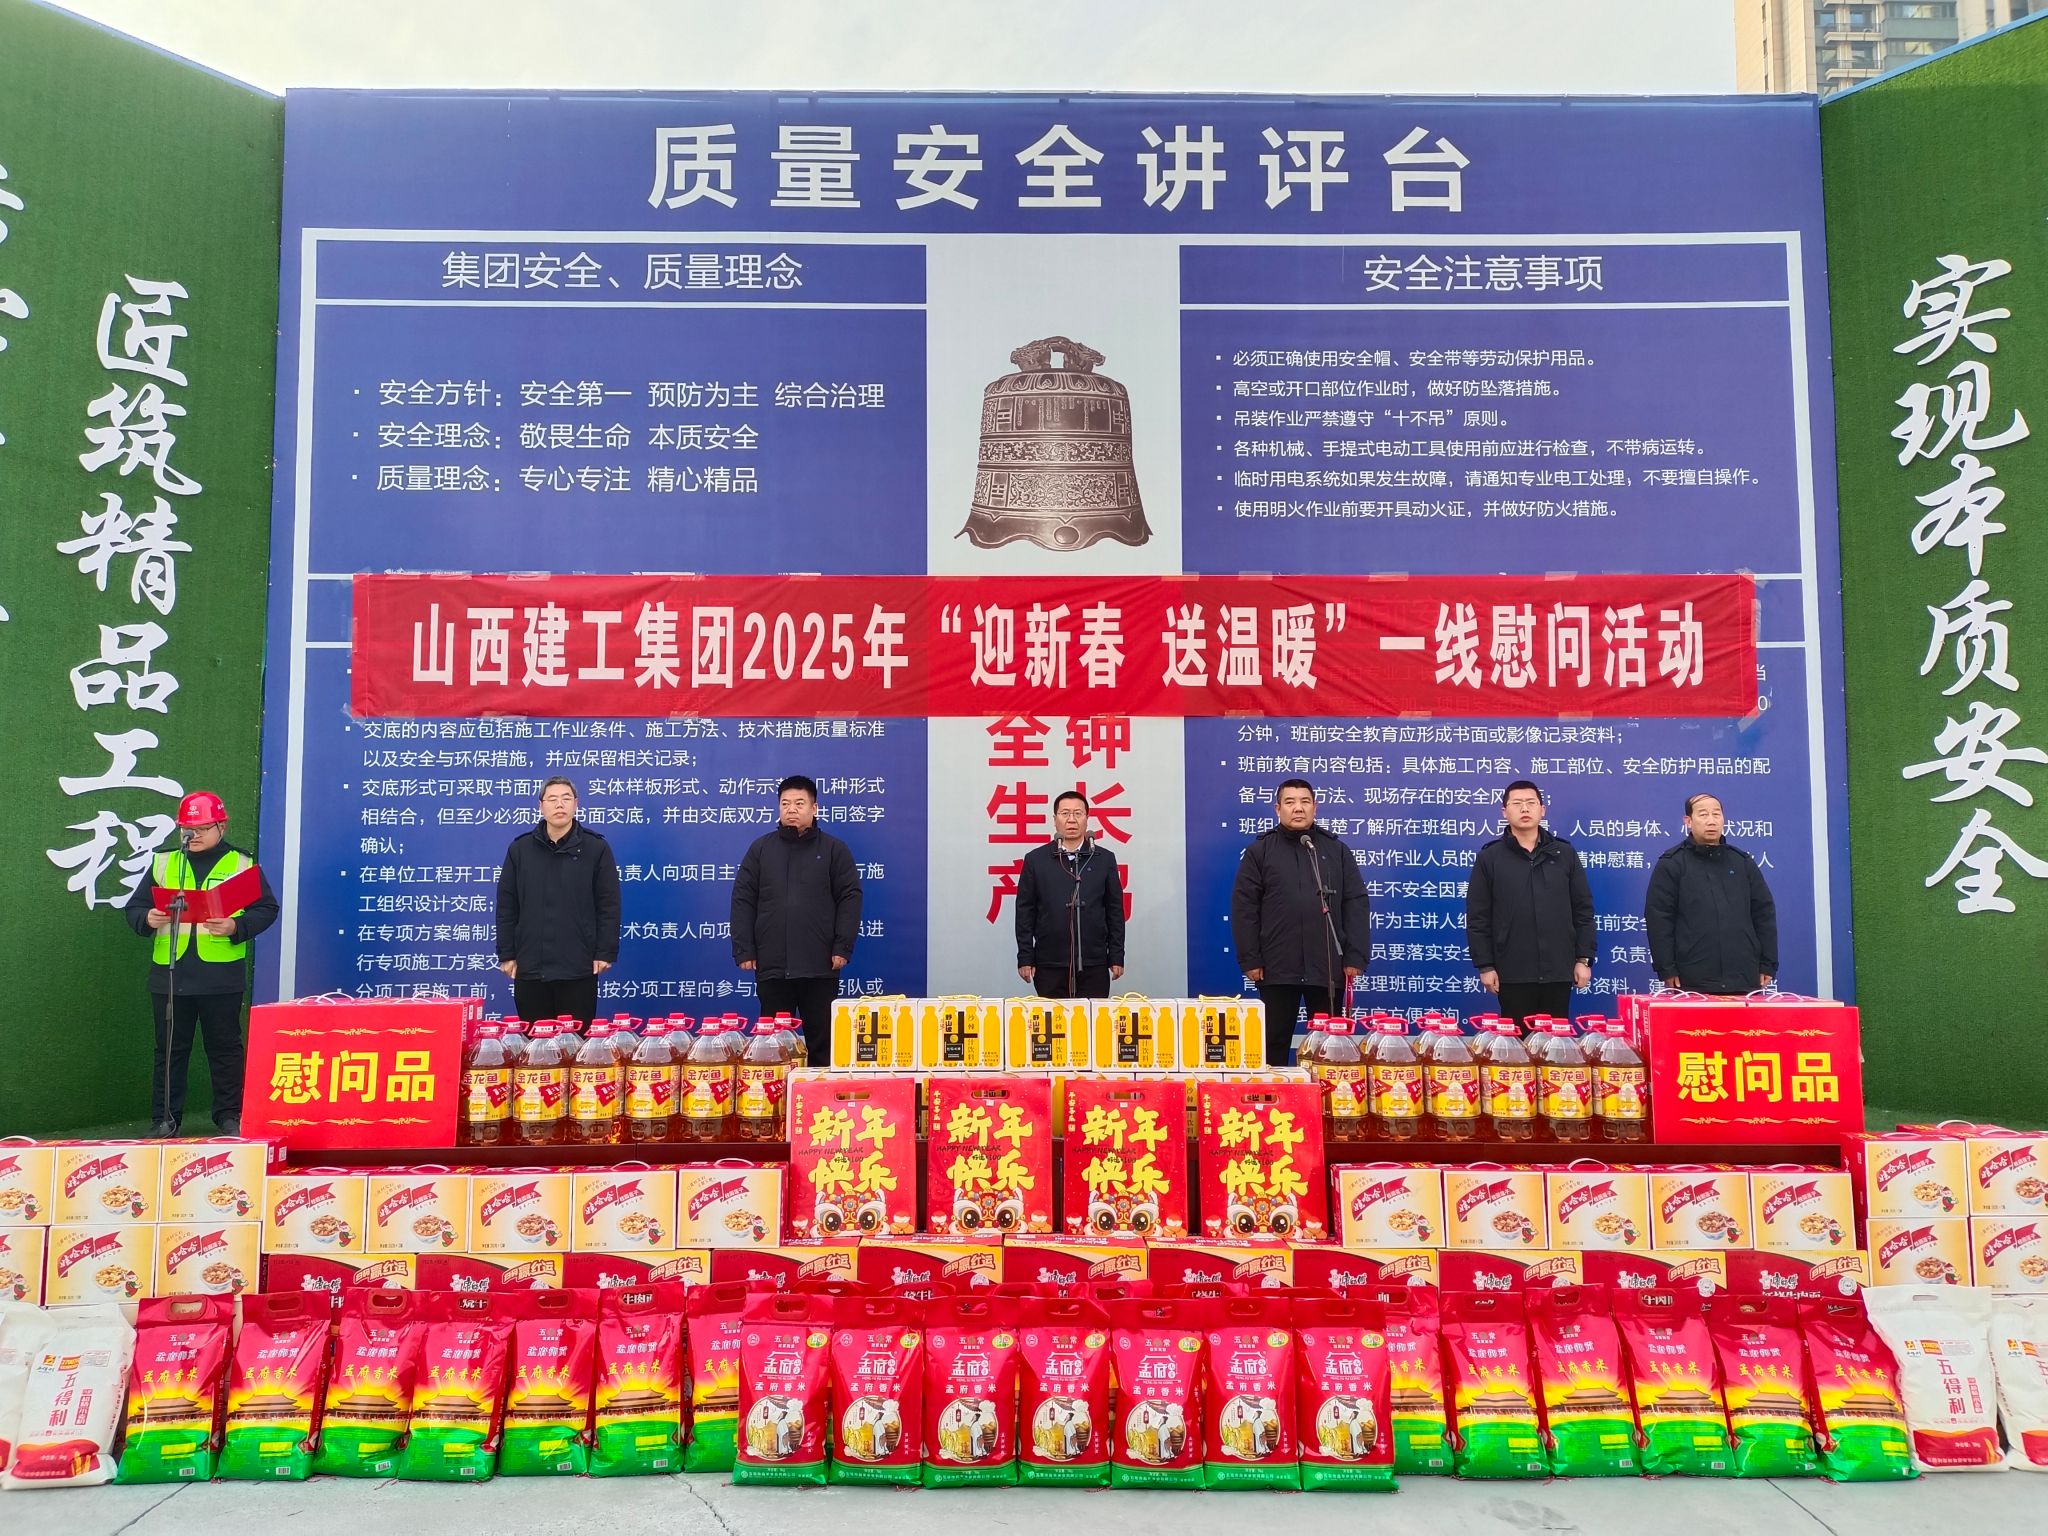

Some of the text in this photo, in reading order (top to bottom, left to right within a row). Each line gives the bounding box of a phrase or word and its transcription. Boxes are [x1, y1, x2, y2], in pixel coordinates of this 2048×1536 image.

[648, 124, 1470, 212] 质量安全讲评台
[442, 251, 802, 289] 集团安全、质量理念
[1364, 255, 1603, 291] 安全注意事项
[1234, 350, 1593, 367] 必须正确使用安全帽、安全带等劳动保护用品。
[648, 381, 759, 407] 预防为主
[775, 382, 885, 408] 综合治理
[1233, 380, 1559, 397] 高空或开口部位作业时，做好防坠落措施。
[649, 424, 758, 450] 本质安全
[1234, 438, 1703, 457] 各种机械、手提式电动工具使用前应进行检查，不带病运转。
[648, 466, 757, 492] 精心精品
[1235, 500, 1616, 517] 使用明火作业前要开具动火证，并做好防火措施。
[43, 273, 203, 911] 匠筑精品工程
[1891, 254, 2048, 913] 实现本质安全
[361, 837, 403, 854] 确认；
[1364, 880, 1470, 899] 生不安全因素
[357, 921, 732, 942] 在专项方案编制 术负责人向项
[595, 980, 758, 998] 按分项工程向参与
[1353, 975, 1490, 993] 整理班前安全教
[268, 1050, 436, 1104] 慰问品
[517, 1072, 551, 1084] 金龙鱼
[574, 1072, 608, 1084] 金龙鱼
[630, 1070, 664, 1082] 金龙鱼
[688, 1070, 722, 1082] 金龙鱼
[745, 1069, 779, 1081] 金龙鱼
[1325, 1068, 1359, 1080] 金龙鱼
[1381, 1068, 1415, 1080] 金龙鱼
[1436, 1068, 1470, 1080] 金龙鱼
[1498, 1069, 1532, 1081] 金龙鱼
[1551, 1069, 1585, 1081] 金龙鱼
[1609, 1069, 1643, 1081] 金龙鱼
[1677, 1050, 1840, 1103] 慰问品
[808, 1104, 896, 1148] 新年
[946, 1102, 1033, 1148] 新年
[1082, 1104, 1168, 1151] 新年
[1217, 1106, 1305, 1153] 新年
[67, 1164, 97, 1188] 娃哈哈
[173, 1163, 204, 1187] 娃哈哈
[807, 1151, 897, 1192] 快乐
[946, 1149, 1035, 1191] 快乐
[1081, 1152, 1170, 1195] 快乐
[1219, 1153, 1309, 1196] 快乐
[1879, 1158, 1906, 1182] 娃哈哈
[1981, 1156, 2008, 1180] 娃哈哈
[277, 1193, 305, 1217] 娃哈哈
[379, 1193, 409, 1217] 娃哈哈
[483, 1192, 512, 1217] 娃哈哈
[585, 1190, 614, 1214] 娃哈哈
[690, 1188, 720, 1212] 娃哈哈
[1354, 1188, 1381, 1213] 娃哈哈
[1459, 1190, 1487, 1214] 娃哈哈
[1560, 1191, 1589, 1216] 娃哈哈
[1664, 1191, 1693, 1215] 娃哈哈
[1765, 1191, 1794, 1215] 娃哈哈
[60, 1243, 91, 1267] 娃哈哈
[168, 1241, 198, 1266] 娃哈哈
[1881, 1236, 1908, 1260] 娃哈哈
[1985, 1234, 2011, 1258] 娃哈哈
[48, 1371, 79, 1426] 五得利
[1937, 1359, 1966, 1415] 五得利
